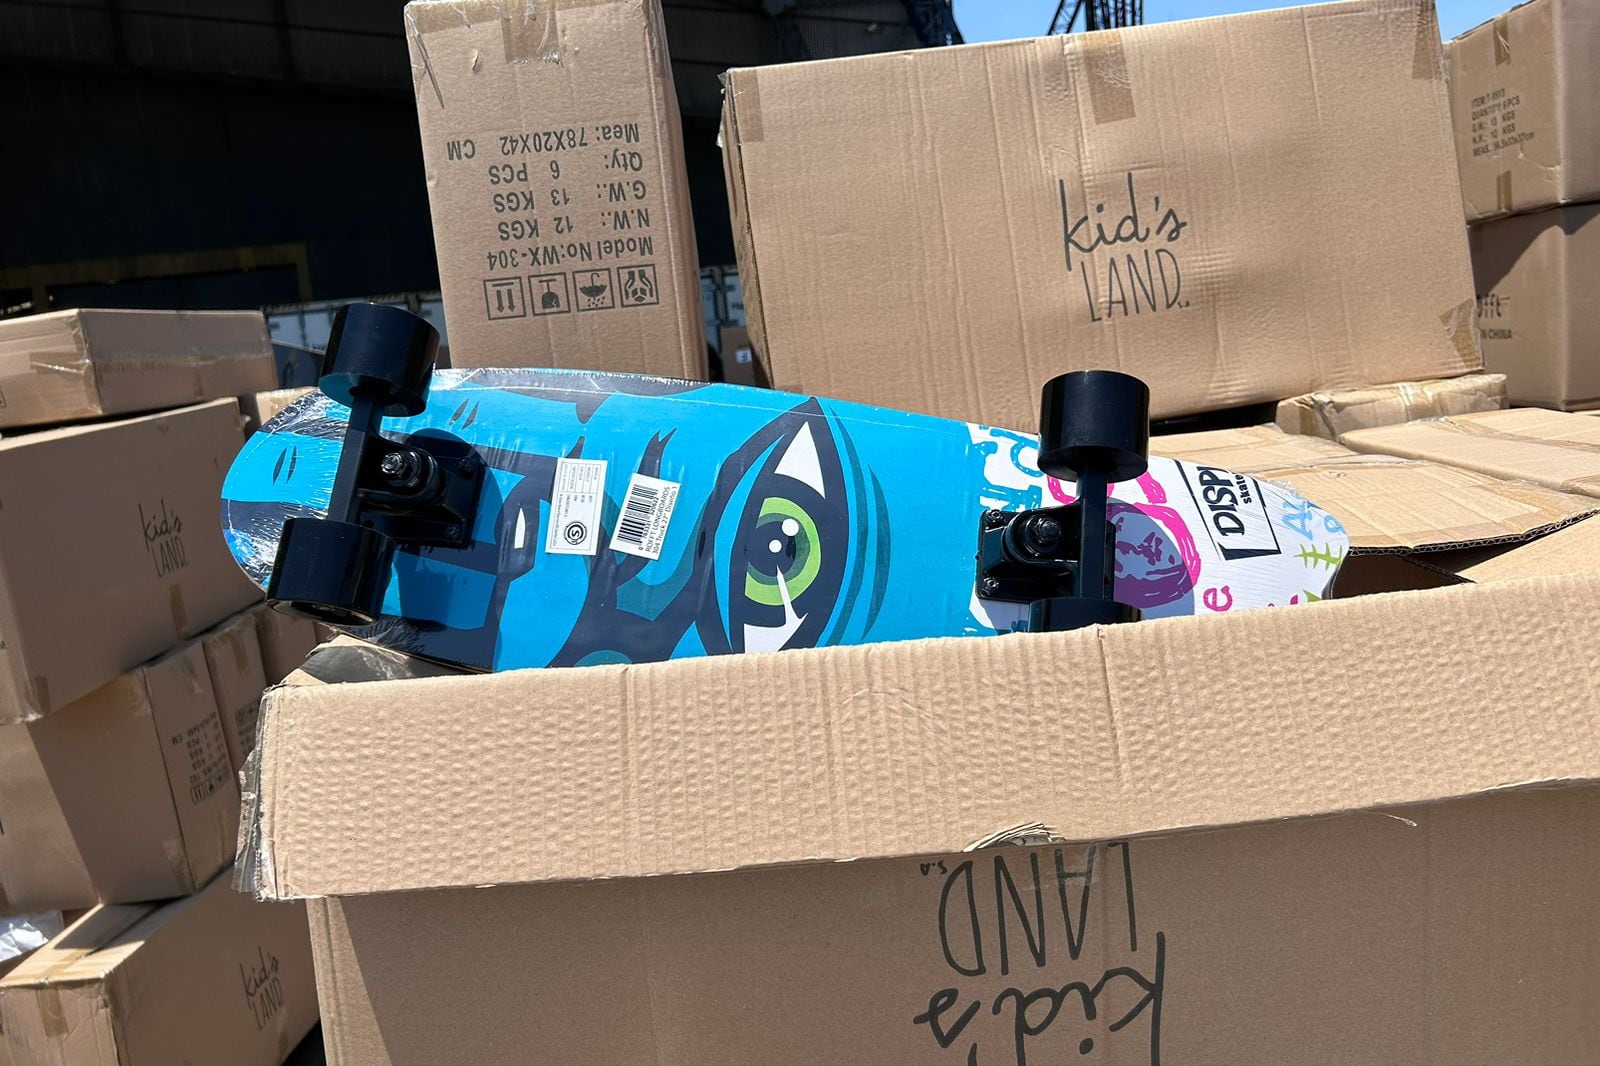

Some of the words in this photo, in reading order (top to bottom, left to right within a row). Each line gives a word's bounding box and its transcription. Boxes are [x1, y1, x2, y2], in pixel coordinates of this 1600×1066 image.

[499, 127, 587, 156] 78X20X42
[595, 123, 639, 144] Mea:
[447, 139, 476, 160] CM
[550, 160, 560, 180] 6
[604, 149, 643, 172] Qty:
[488, 163, 527, 184] PCS
[493, 190, 534, 212] KGS
[551, 188, 570, 206] 13
[597, 180, 646, 201] G.W.:
[498, 219, 539, 241] KGS
[553, 216, 574, 234] 12
[600, 209, 650, 230] N.W.:
[1059, 171, 1187, 272] kid's
[597, 236, 653, 260] Model
[1080, 248, 1181, 323] LAND
[645, 531, 656, 552] ROFFT
[657, 525, 666, 543] Truck
[151, 536, 187, 578] LAND
[938, 840, 1137, 978] LAND
[912, 932, 1166, 1066] kid's
